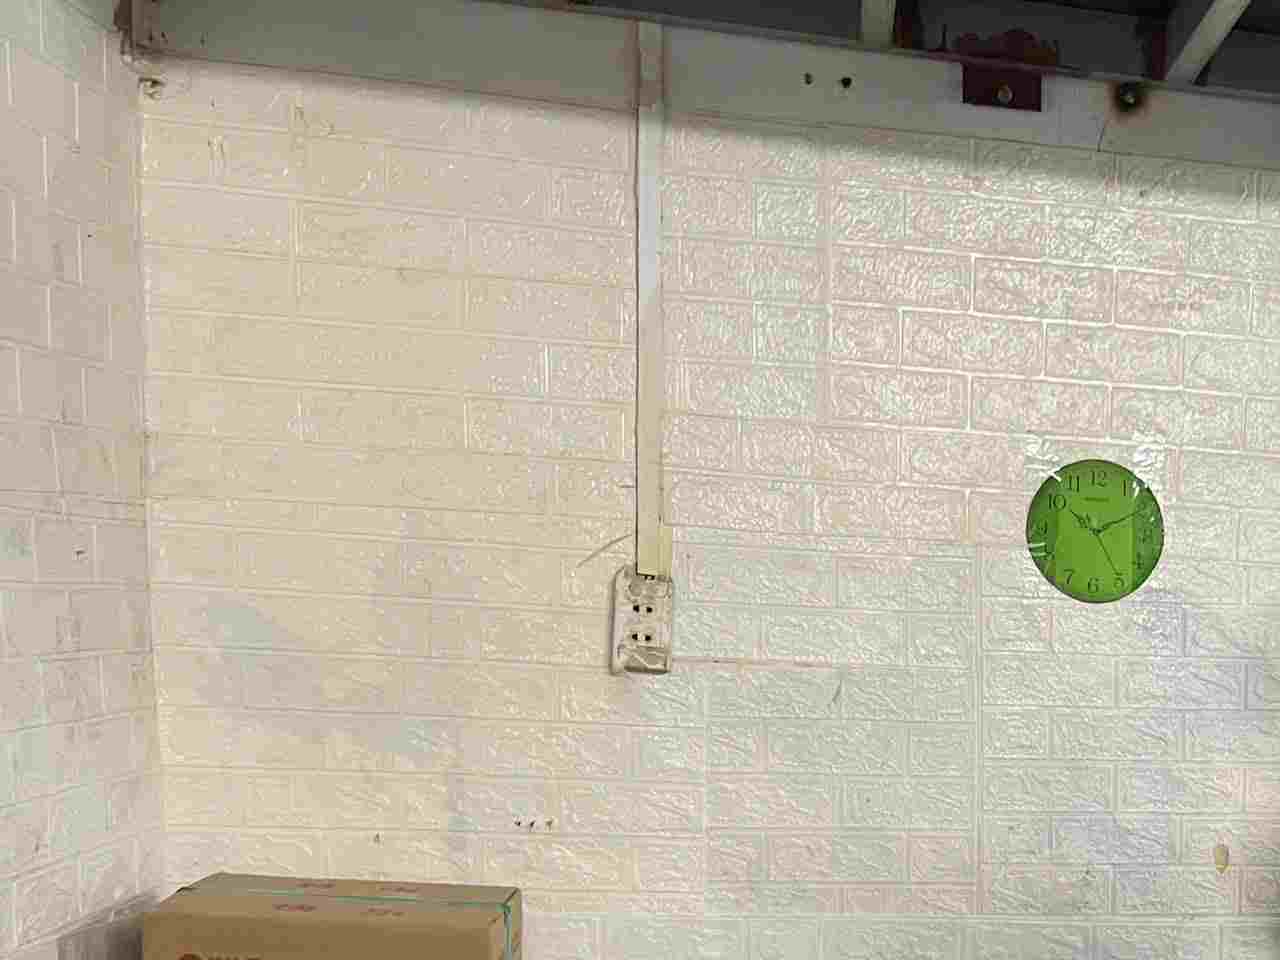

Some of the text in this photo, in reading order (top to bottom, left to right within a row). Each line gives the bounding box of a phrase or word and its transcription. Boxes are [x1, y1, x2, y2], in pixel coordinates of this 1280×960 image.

[1067, 474, 1080, 493] 11
[1089, 470, 1108, 487] 12
[1048, 494, 1066, 511] 10
